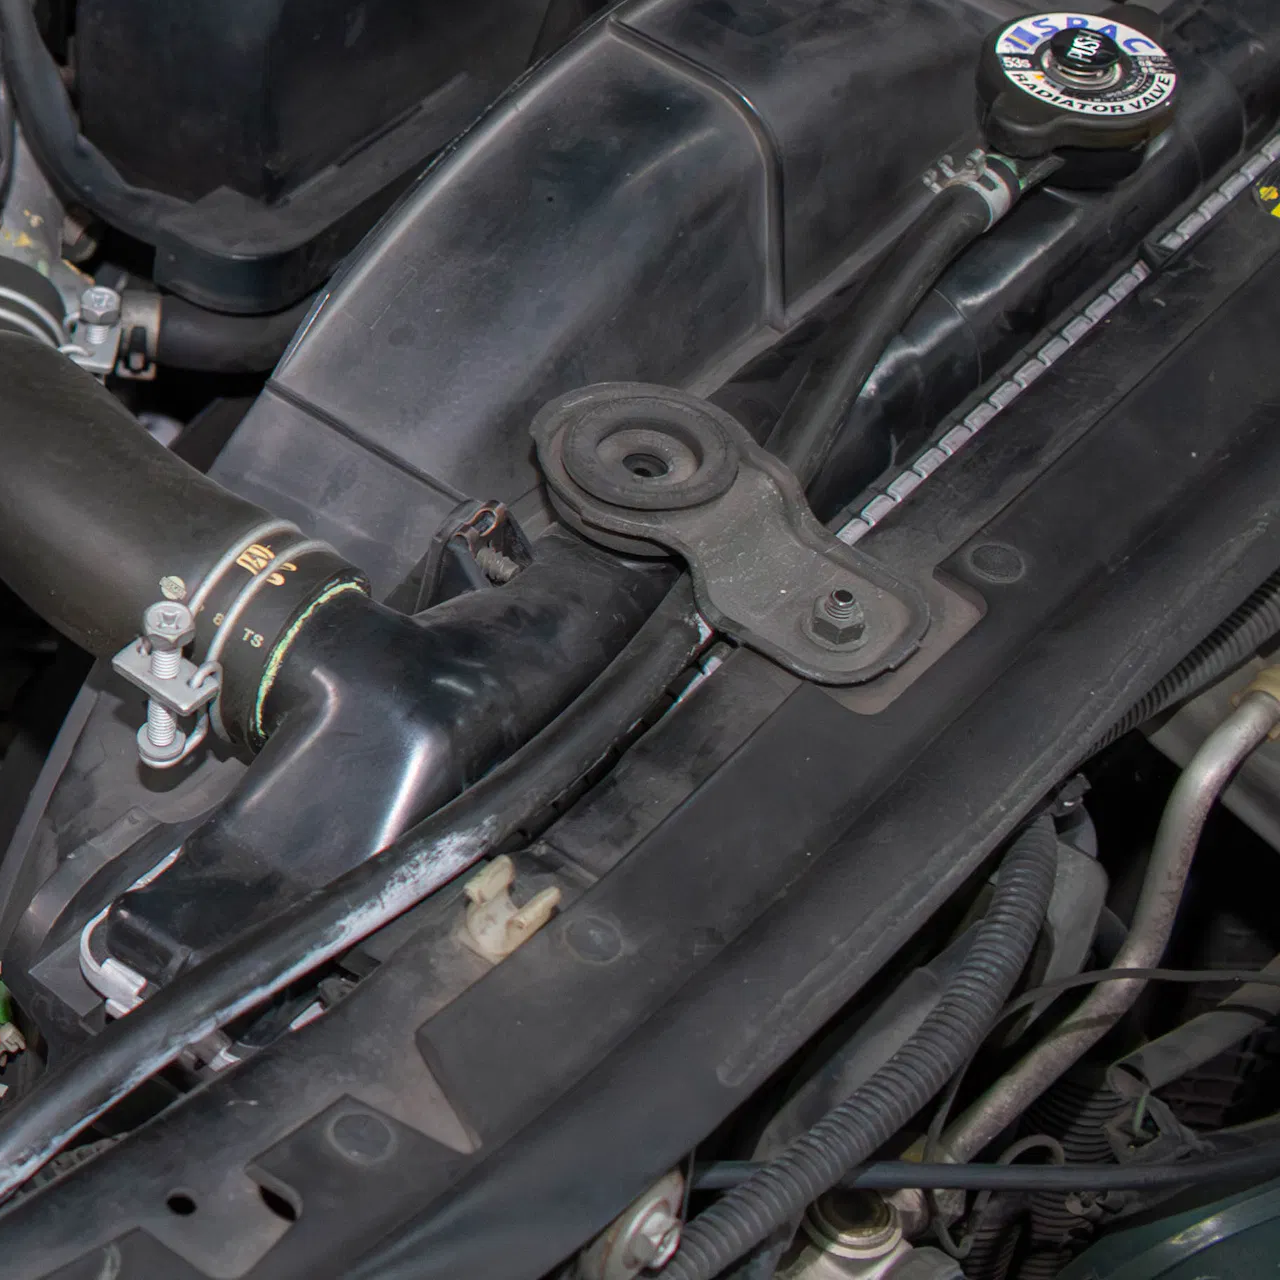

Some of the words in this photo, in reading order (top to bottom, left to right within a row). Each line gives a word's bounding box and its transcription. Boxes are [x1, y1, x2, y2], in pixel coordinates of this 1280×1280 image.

[1067, 29, 1105, 63] PUSH
[1010, 72, 1125, 113] RADIATOR
[1130, 75, 1172, 110] VALVE
[242, 627, 264, 648] TS
